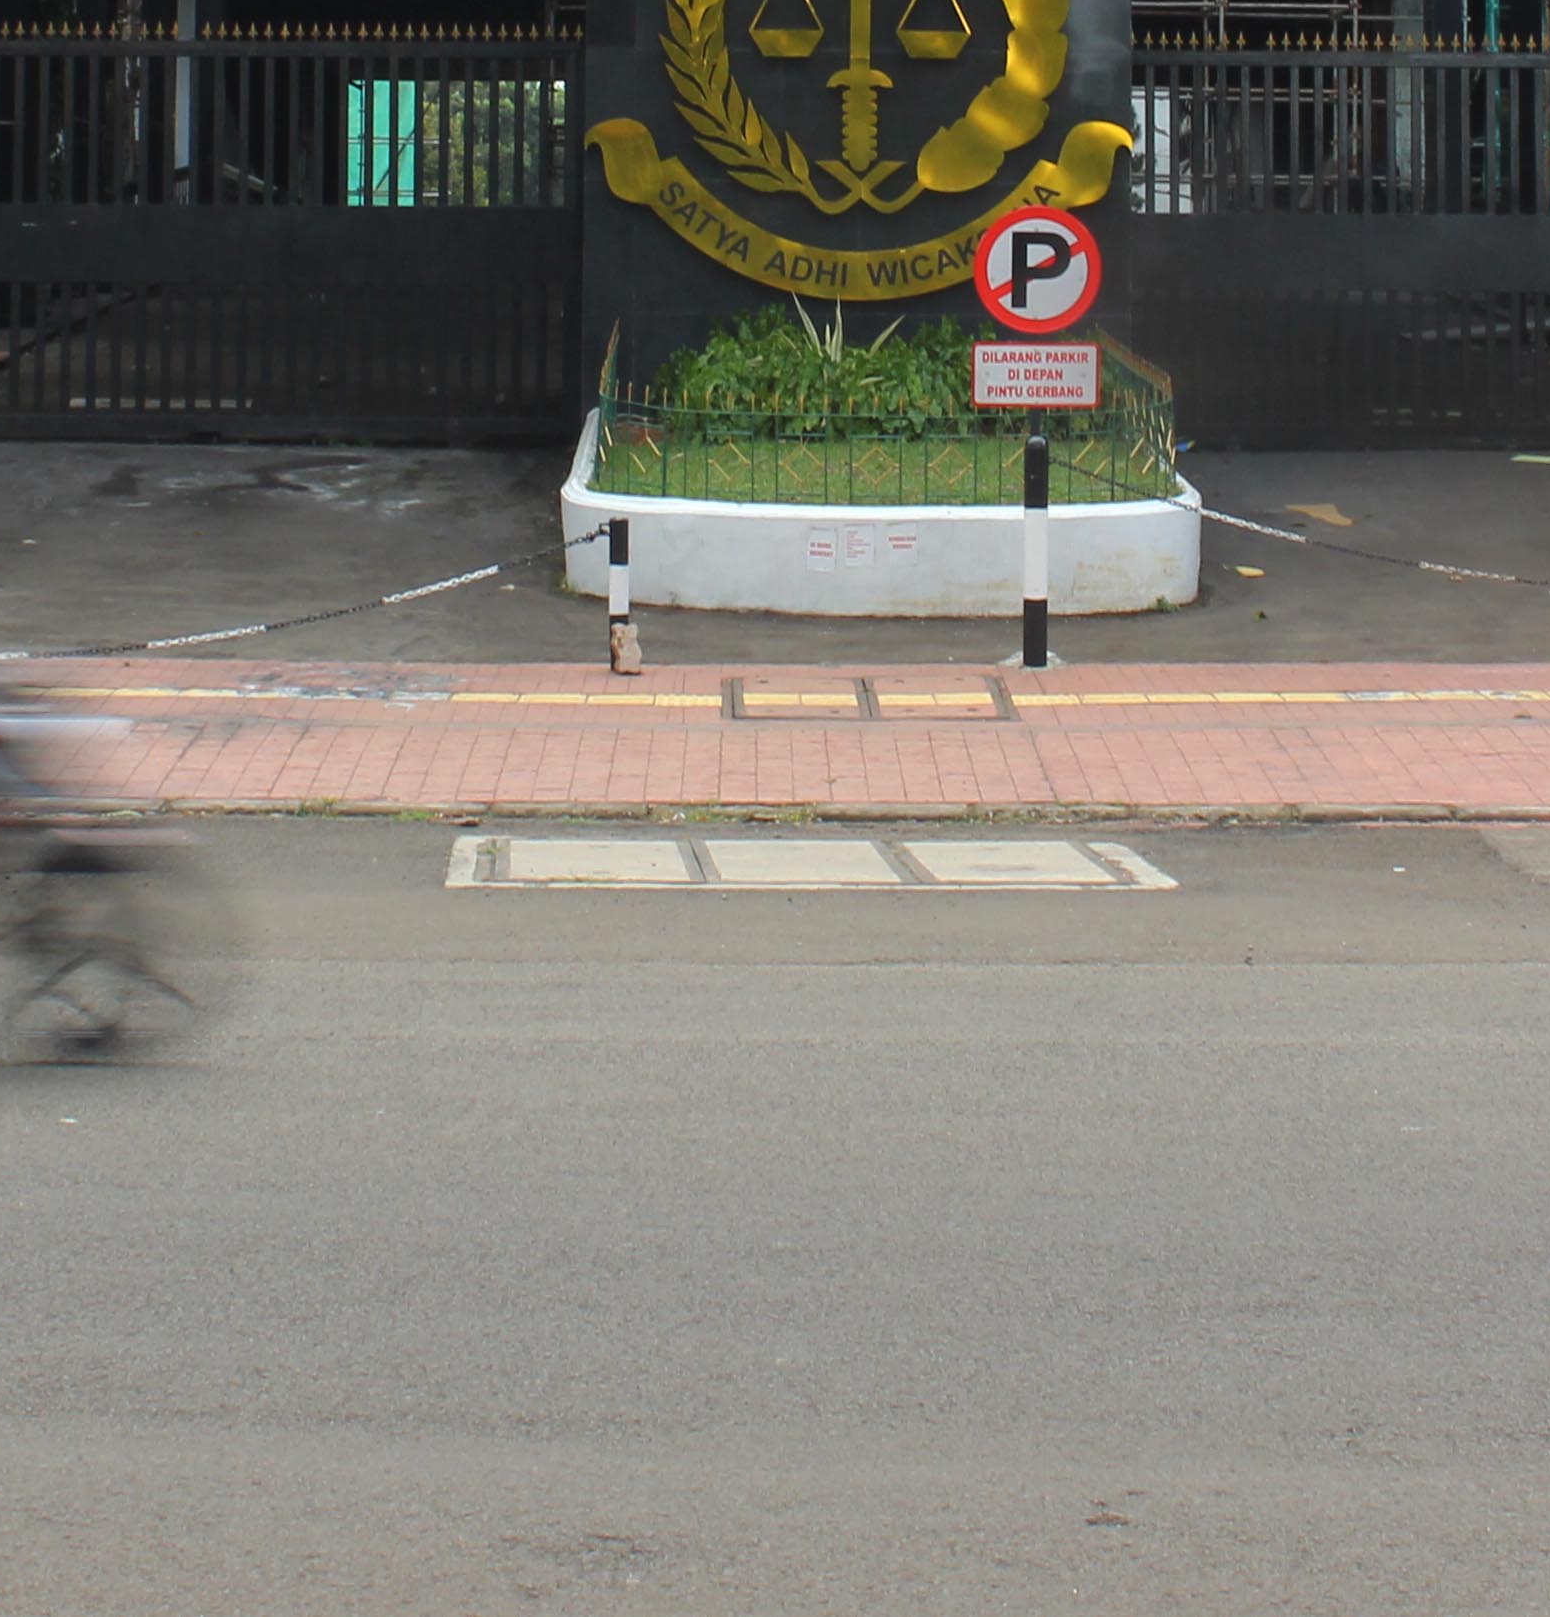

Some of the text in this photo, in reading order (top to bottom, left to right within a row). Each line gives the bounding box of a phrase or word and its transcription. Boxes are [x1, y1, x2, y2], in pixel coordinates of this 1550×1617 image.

[659, 181, 750, 263] SATYA
[764, 250, 849, 288] ADHI
[1010, 232, 1071, 308] P
[982, 351, 1089, 364] DILARANG PARKIR
[1008, 369, 1063, 381] DI DEPAN
[987, 386, 1083, 398] PINTU GERBANG
